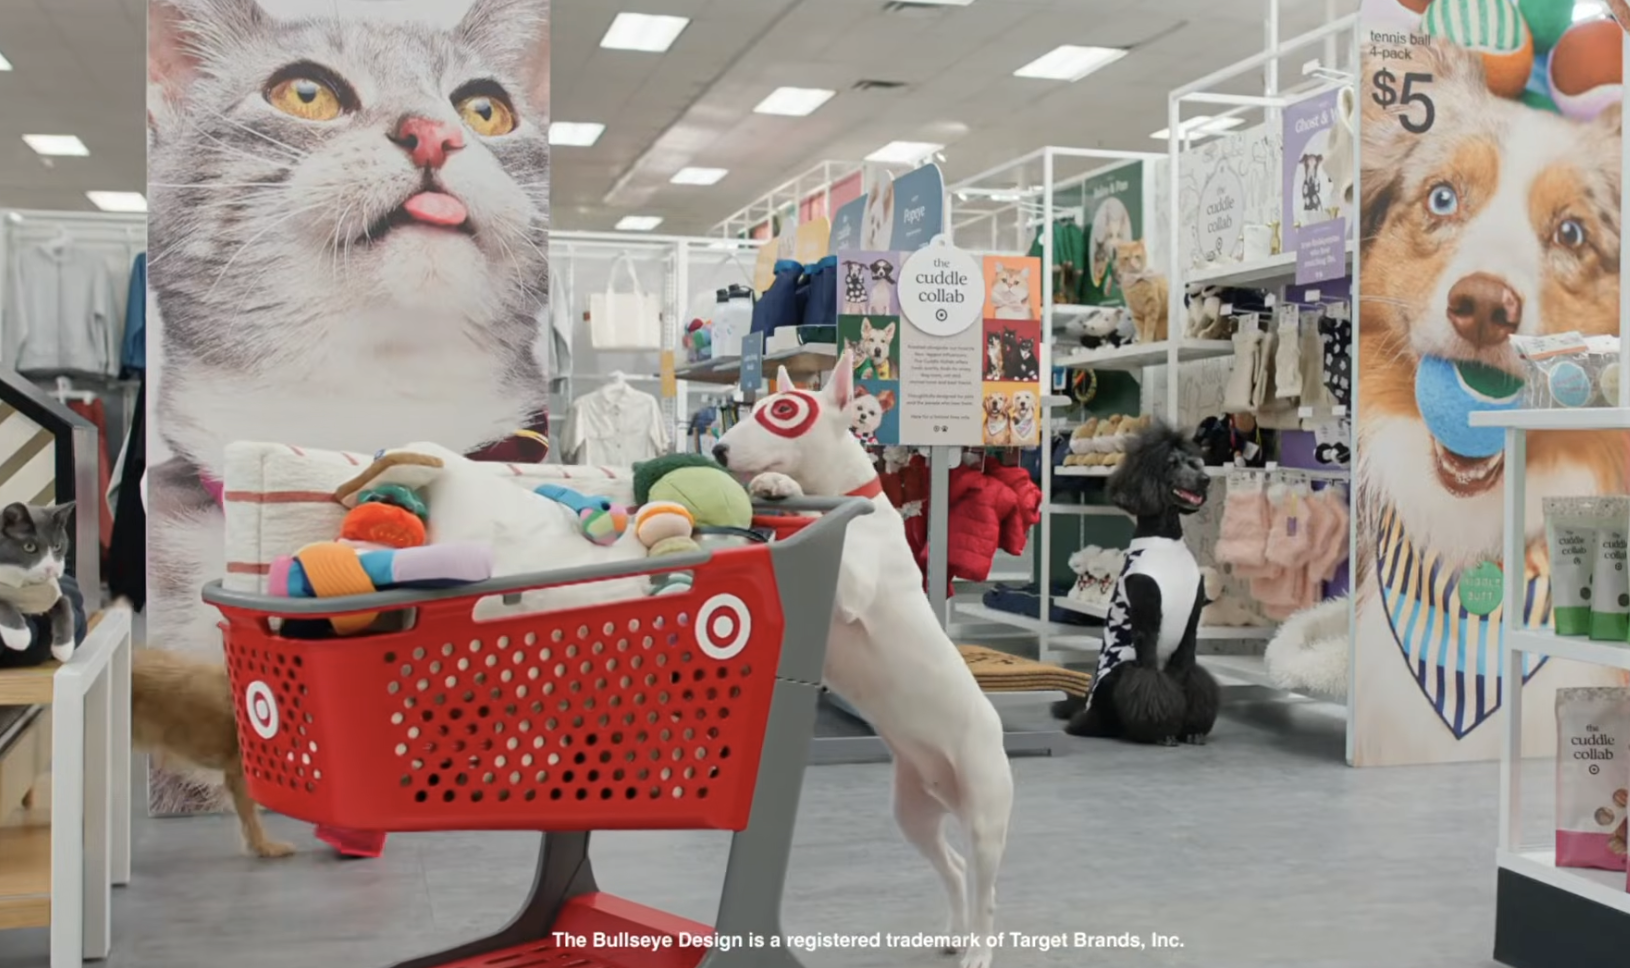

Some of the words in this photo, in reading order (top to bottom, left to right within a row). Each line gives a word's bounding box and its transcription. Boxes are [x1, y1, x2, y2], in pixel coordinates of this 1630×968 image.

[1370, 31, 1407, 45] tennis
[1409, 33, 1431, 46] ball
[1369, 46, 1412, 60] 4-pack
[1371, 67, 1436, 134] $5
[1295, 115, 1319, 133] Ghost
[1320, 110, 1329, 125] &
[1206, 195, 1235, 215] cuddle
[903, 205, 926, 224] Popeye
[1208, 214, 1233, 233] collab
[933, 257, 950, 268] the
[915, 270, 968, 286] cuddle
[918, 288, 965, 303] collab
[1558, 536, 1585, 545] cuddle
[1561, 546, 1587, 555] collab
[1586, 724, 1599, 732] the
[1571, 734, 1615, 746] cuddle
[1573, 748, 1614, 760] collab
